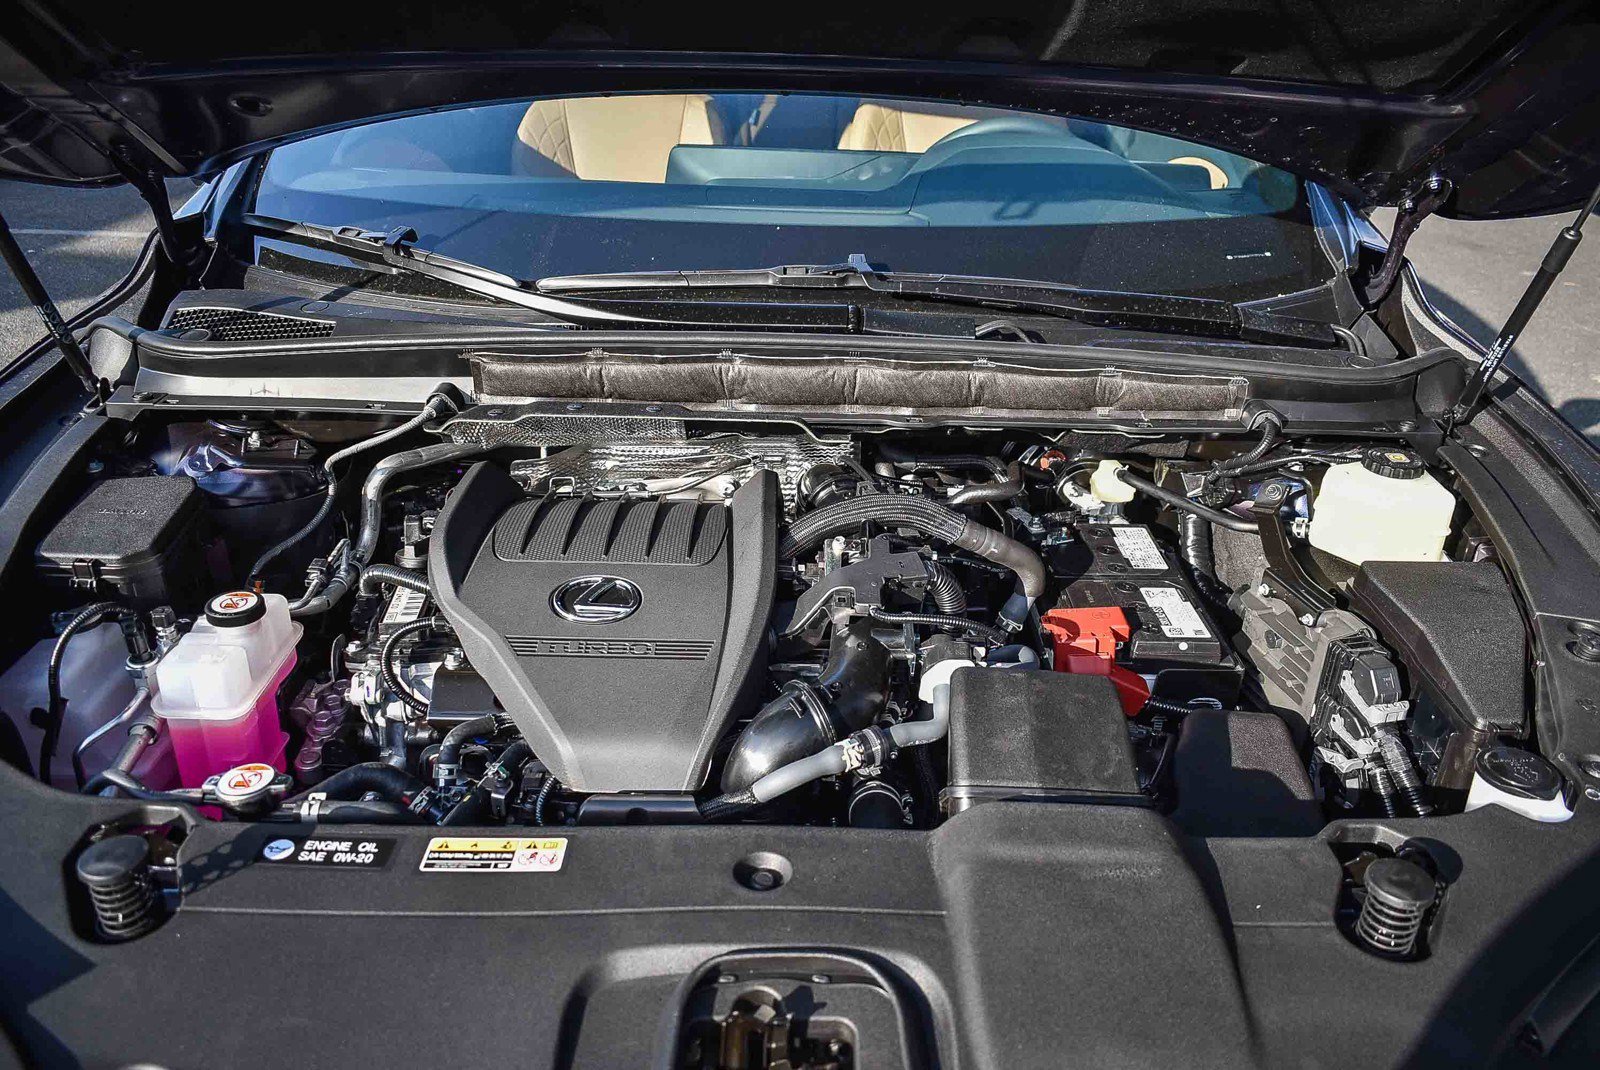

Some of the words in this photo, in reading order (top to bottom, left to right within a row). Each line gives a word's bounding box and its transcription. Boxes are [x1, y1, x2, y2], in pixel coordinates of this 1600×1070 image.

[540, 639, 654, 656] TURBO
[303, 840, 353, 852] ENGINE
[357, 841, 379, 853] OIL
[298, 851, 328, 862] SAE
